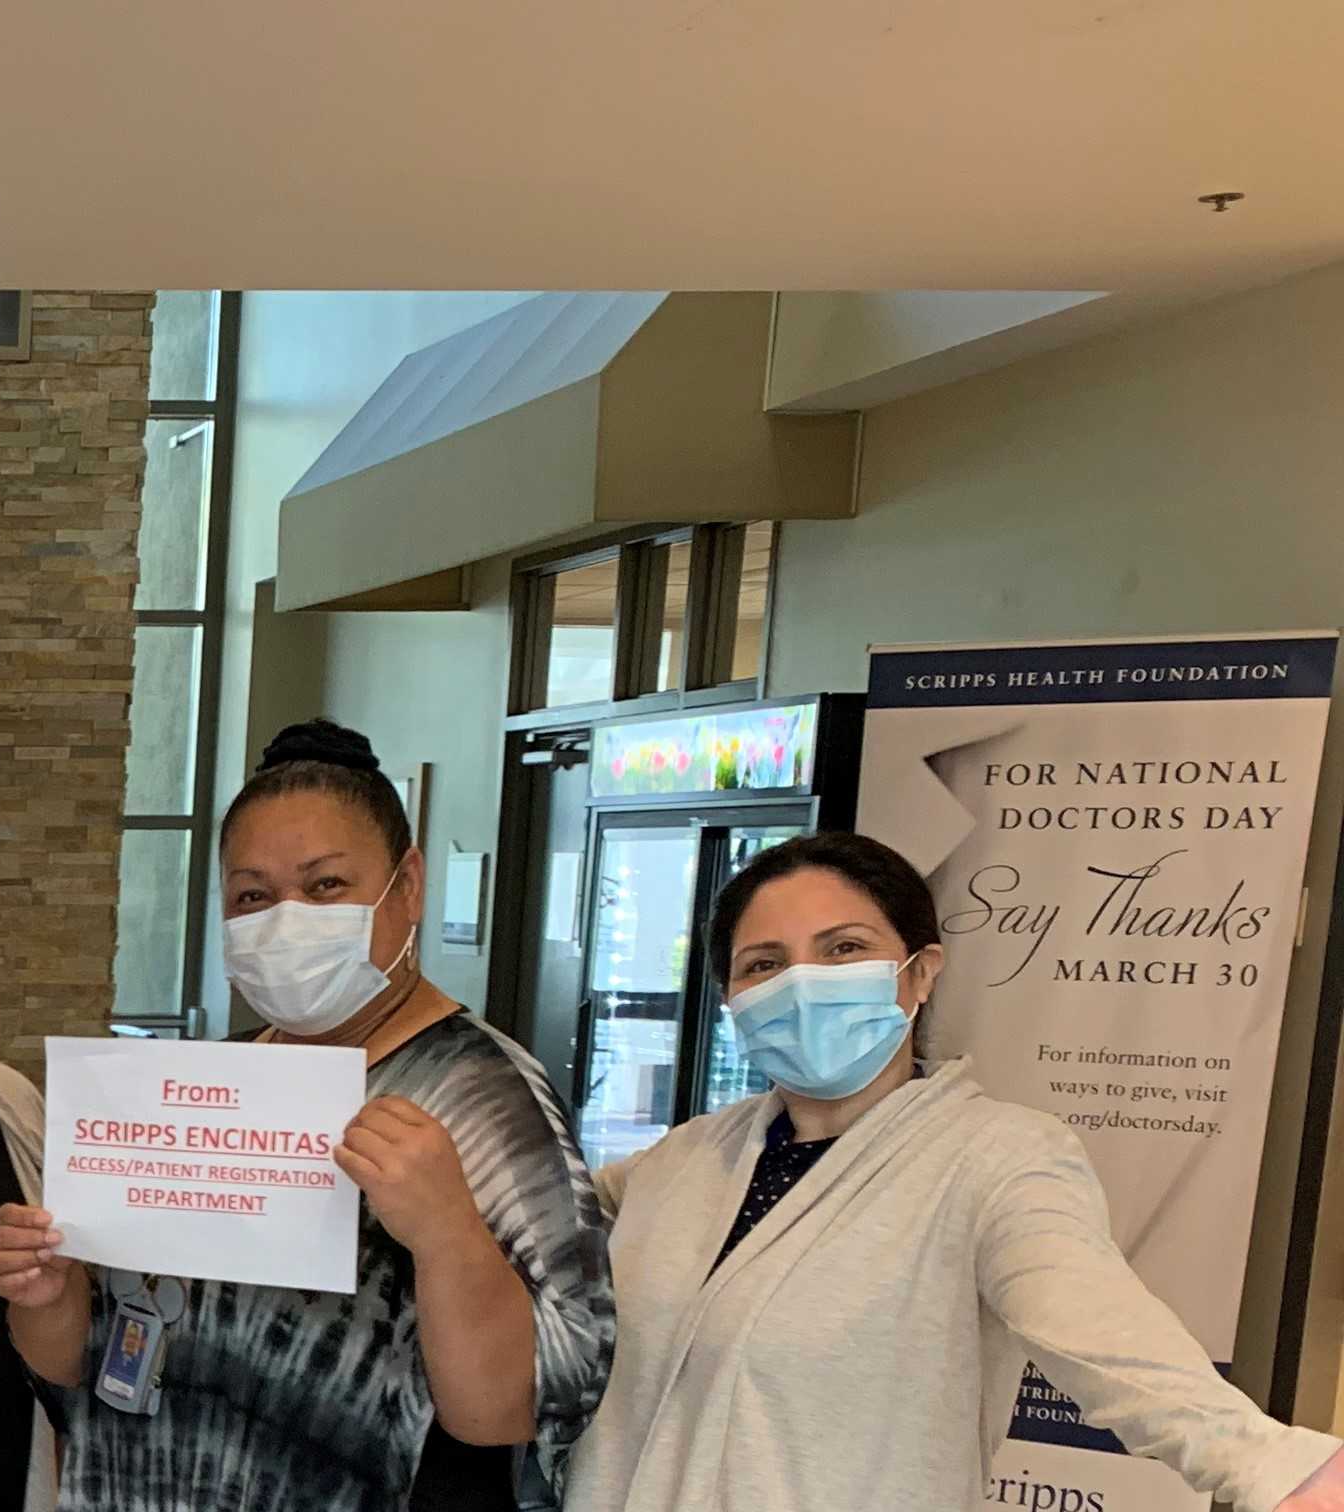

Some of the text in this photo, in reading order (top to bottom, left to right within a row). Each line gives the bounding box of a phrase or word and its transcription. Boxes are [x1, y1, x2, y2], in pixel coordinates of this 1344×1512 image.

[904, 663, 1291, 691] SCRIPPS HEALTH FOUNDATION
[983, 760, 1288, 787] FOR NATIONAL
[998, 806, 1285, 831] DOCTORS DAY
[941, 849, 1272, 988] Say Thanks
[1052, 958, 1260, 988] MARCH 30
[1037, 1044, 1232, 1071] For information on
[162, 1079, 240, 1104] From:
[1049, 1080, 1229, 1103] ways to give, visit
[74, 1118, 331, 1155] SCRIPPS ENCINITAS
[1054, 1109, 1223, 1138] .org/doctorsday.
[66, 1154, 337, 1187] ACCESS/PATIENT REGISTRATION
[126, 1187, 268, 1212] DEPARTMENT
[1026, 1405, 1085, 1425] FOUN
